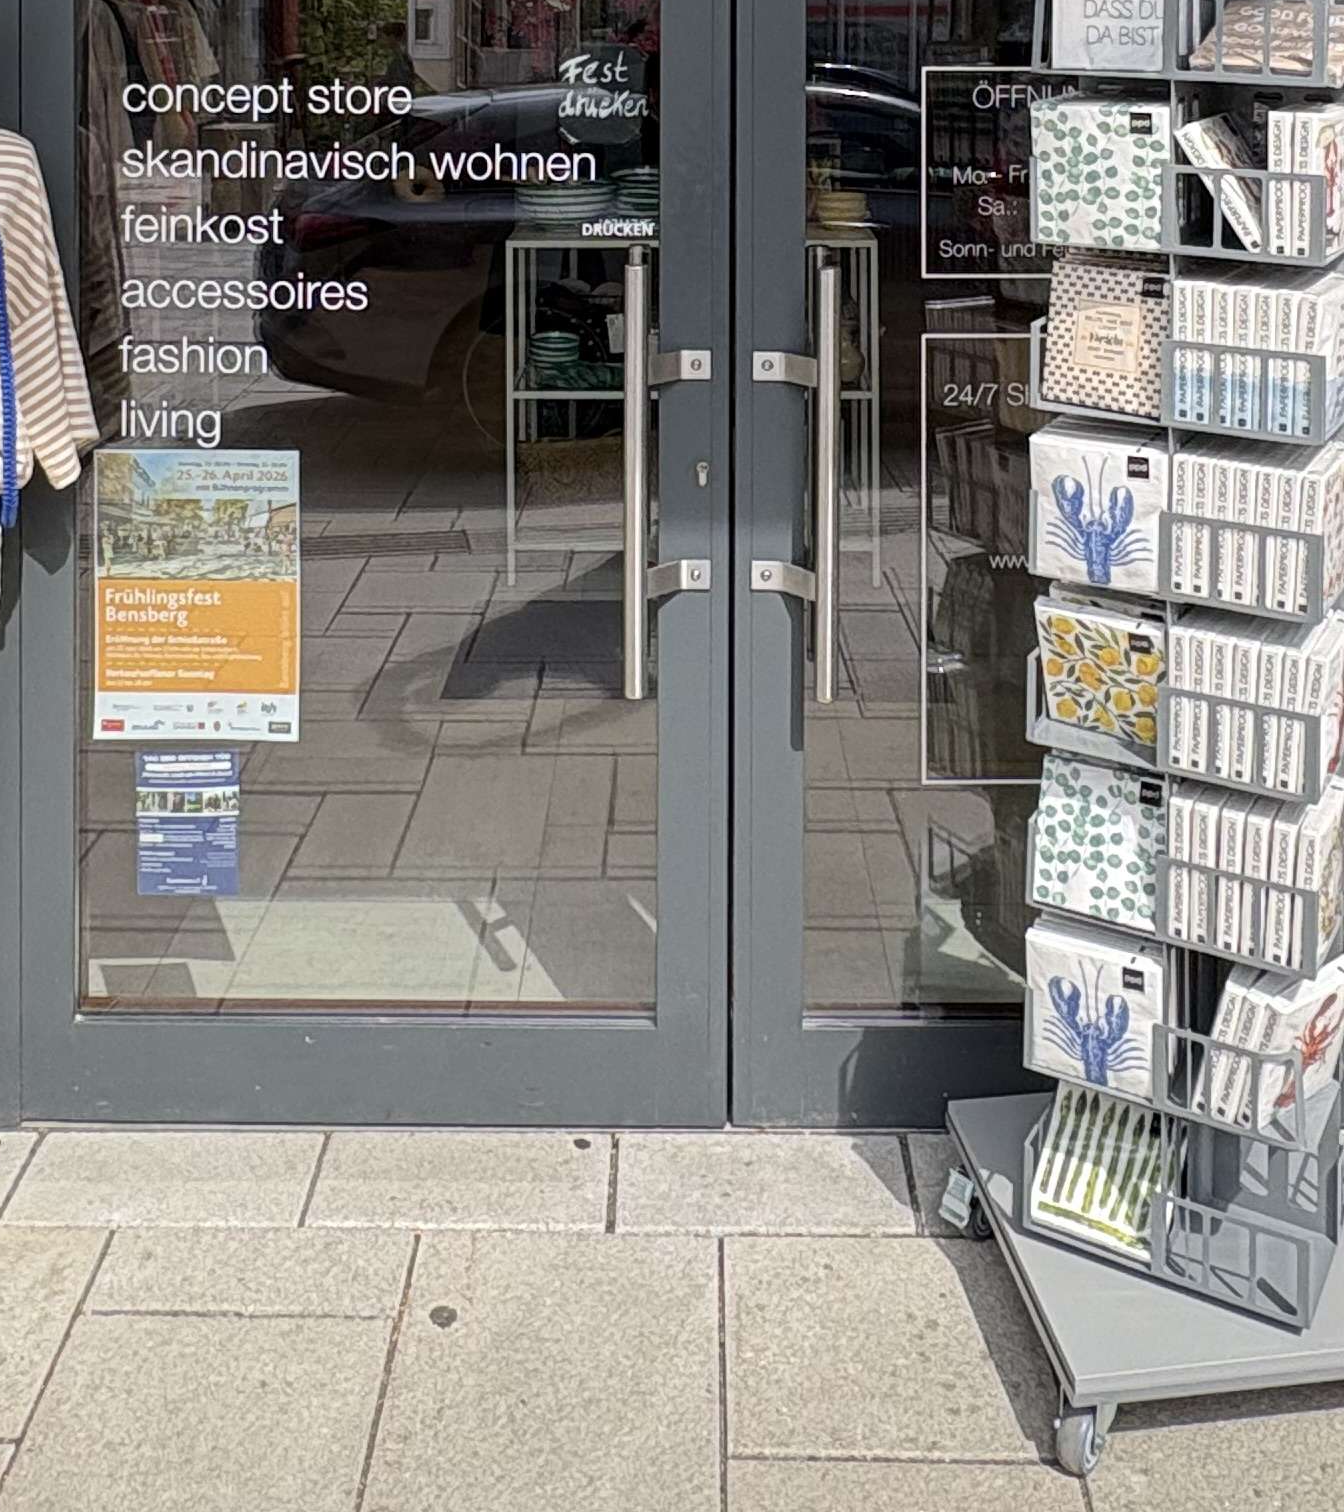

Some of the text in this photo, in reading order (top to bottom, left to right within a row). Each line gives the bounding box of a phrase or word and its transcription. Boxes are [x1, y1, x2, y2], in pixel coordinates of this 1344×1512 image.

[1084, 0, 1133, 19] DASS
[1086, 25, 1160, 46] DA BIST
[559, 50, 630, 85] Fest
[122, 78, 413, 121] concept store
[122, 141, 596, 180] skandinavisch wohnen
[122, 206, 284, 245] feinkost
[939, 239, 995, 258] Sonn-
[1001, 242, 1036, 258] und
[122, 272, 369, 311] accessoires
[119, 336, 269, 375] fashion
[943, 382, 999, 407] 24/7
[120, 399, 223, 448] living
[222, 470, 254, 483] April
[256, 470, 288, 482] 2026
[105, 588, 222, 609] Frühlingsfest
[105, 606, 188, 628] Bensberg
